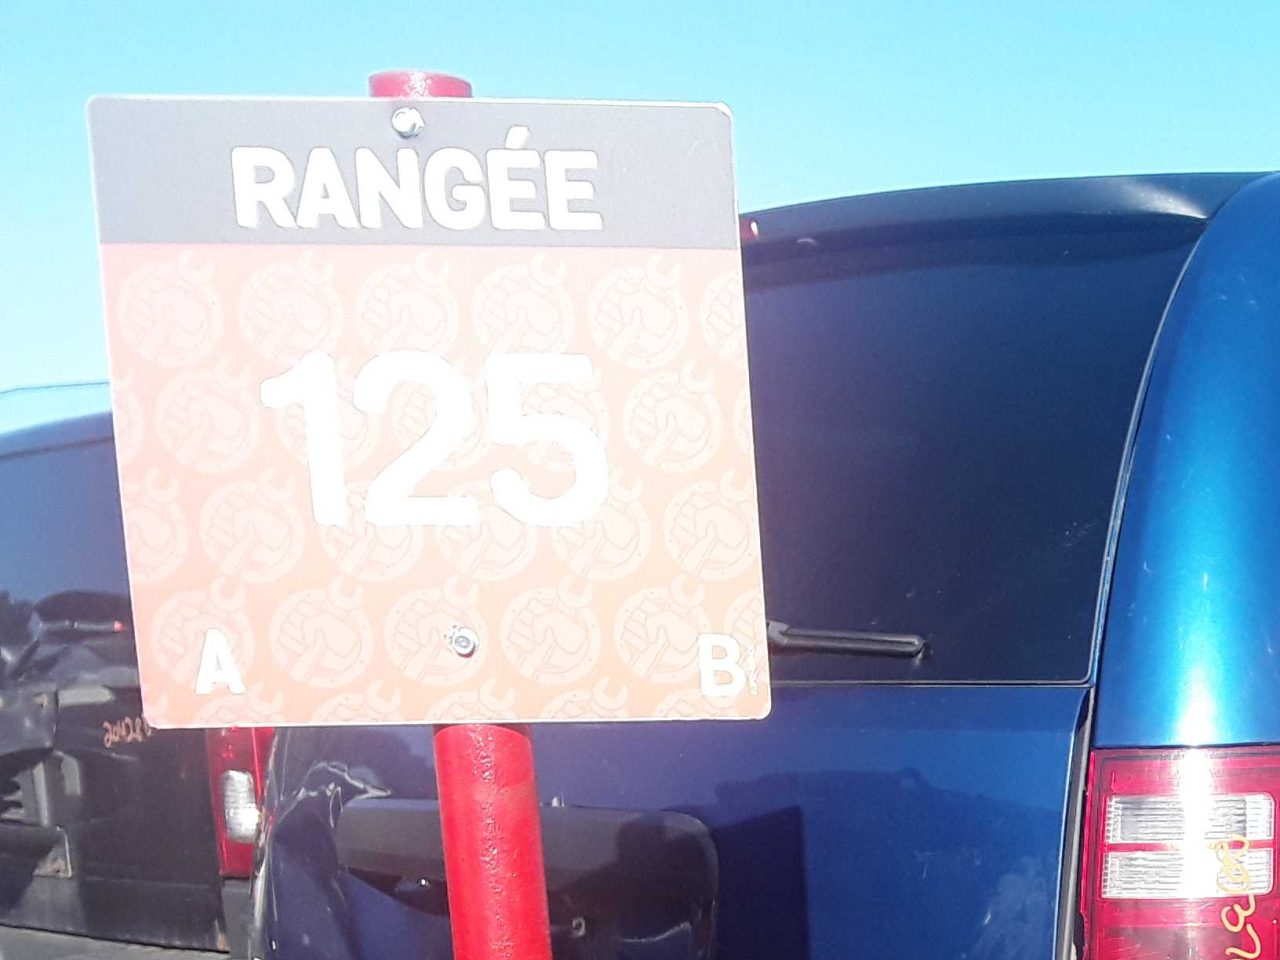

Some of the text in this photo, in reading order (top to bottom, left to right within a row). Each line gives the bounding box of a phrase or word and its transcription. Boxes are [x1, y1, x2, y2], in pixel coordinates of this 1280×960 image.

[230, 125, 604, 231] RANGÉE
[259, 349, 610, 528] 125
[195, 627, 244, 696] A
[698, 632, 746, 698] B
